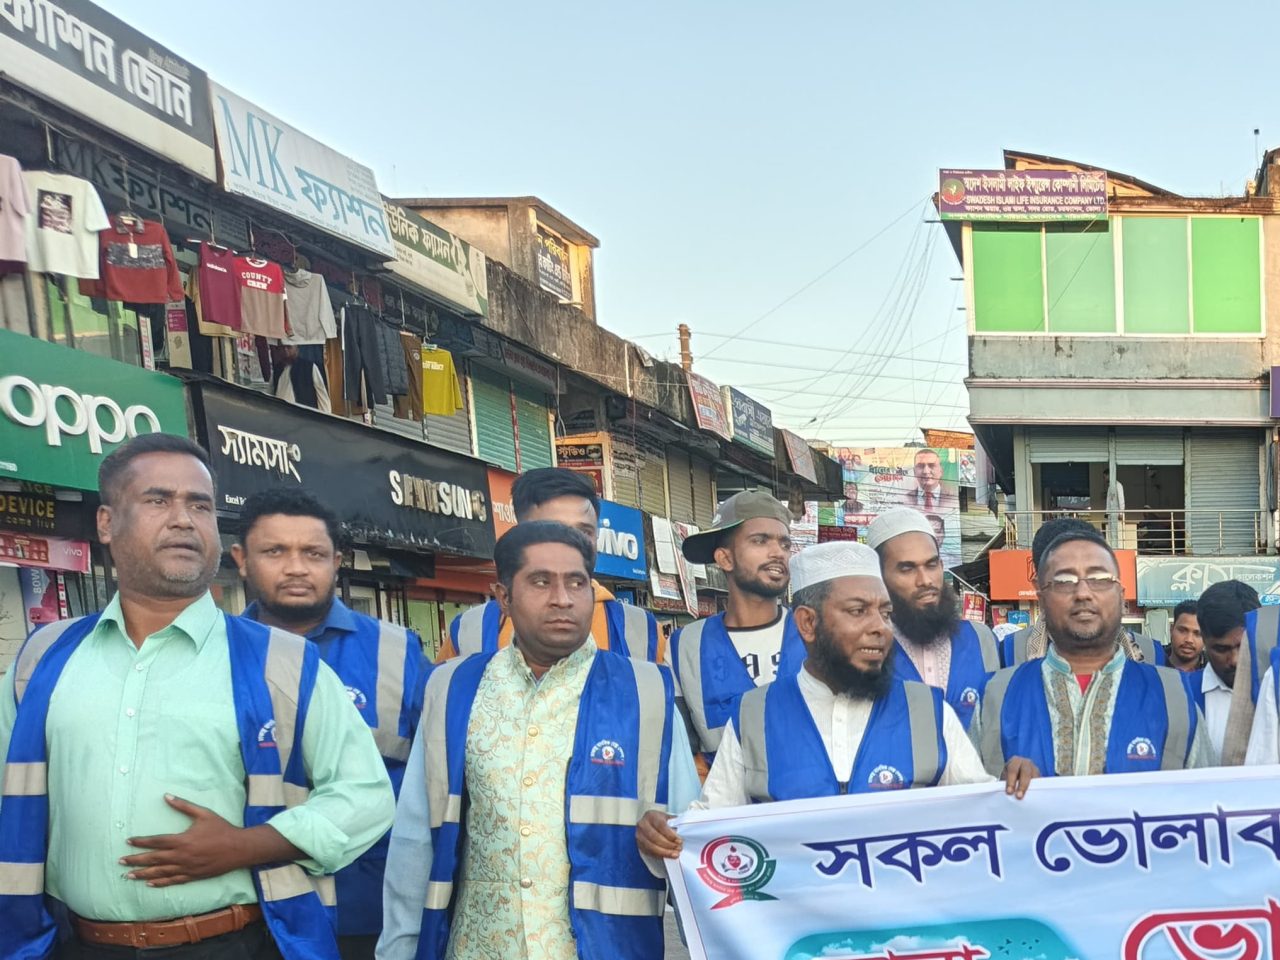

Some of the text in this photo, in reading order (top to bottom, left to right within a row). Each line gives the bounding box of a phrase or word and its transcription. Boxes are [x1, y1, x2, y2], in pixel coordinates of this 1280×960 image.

[122, 49, 192, 126] জোন
[217, 95, 297, 201] MK
[294, 165, 390, 243] ফ্যাশন
[1017, 196, 1030, 205] LIFE
[1030, 196, 1063, 205] INSURANCE
[1064, 196, 1092, 205] COMPANY
[241, 271, 272, 284] COUNTY
[217, 424, 301, 483] স্যামসাং
[0, 494, 55, 518] DEVICE
[63, 547, 83, 557] vivo
[802, 824, 1009, 888] সকল
